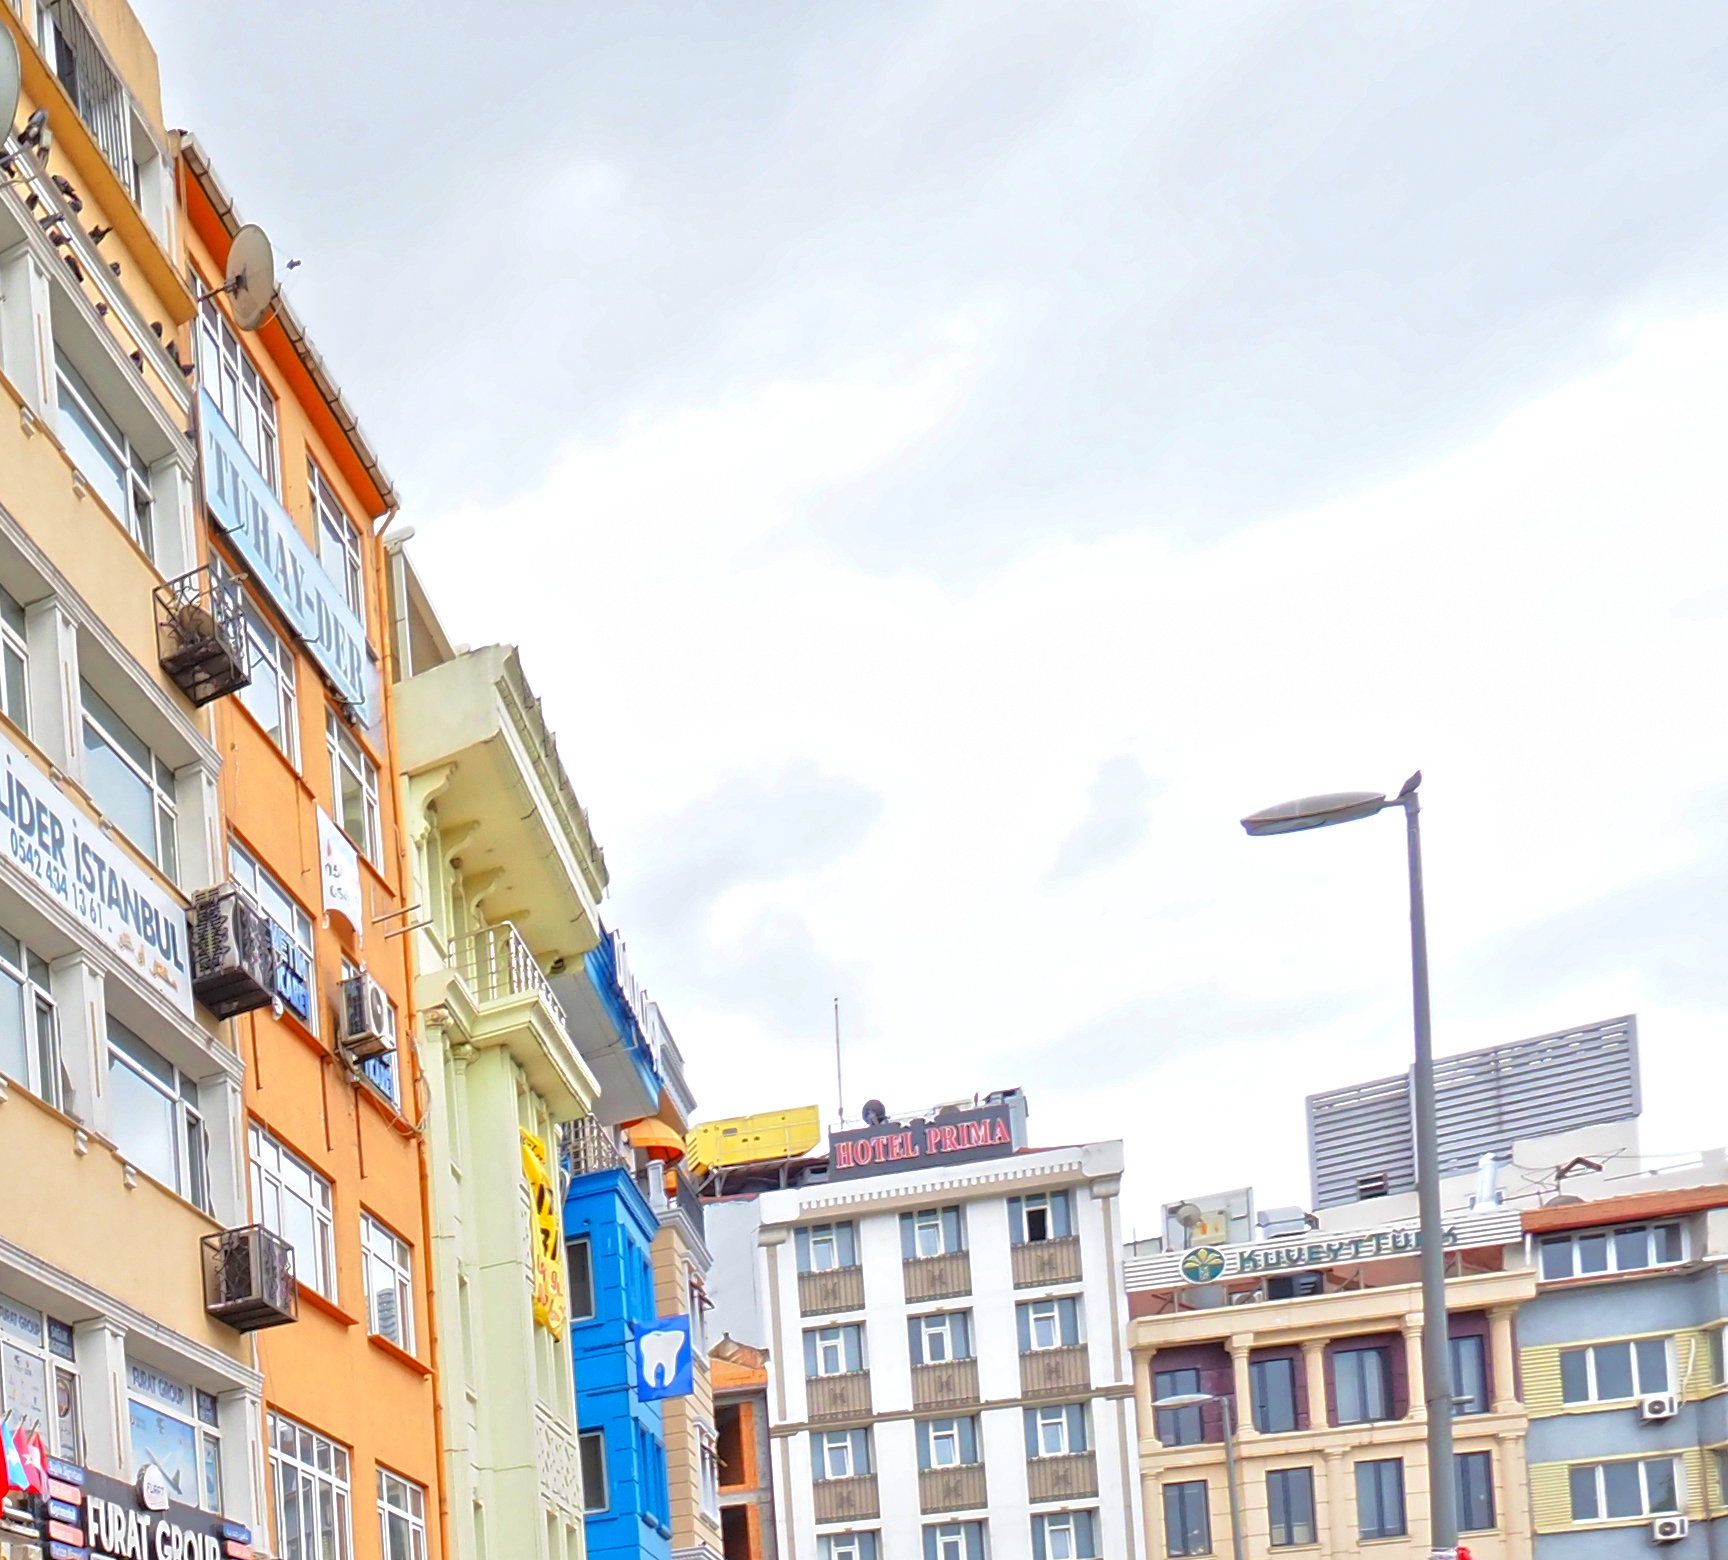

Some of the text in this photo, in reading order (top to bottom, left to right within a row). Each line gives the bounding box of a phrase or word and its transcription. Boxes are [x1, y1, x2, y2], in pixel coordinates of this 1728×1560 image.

[9, 827, 103, 930] 0542 434 13 61
[72, 818, 185, 974] İSTANBUL
[835, 1117, 1011, 1169] HOTEL PRIMA
[1239, 1226, 1459, 1272] KUVEYT TÜK
